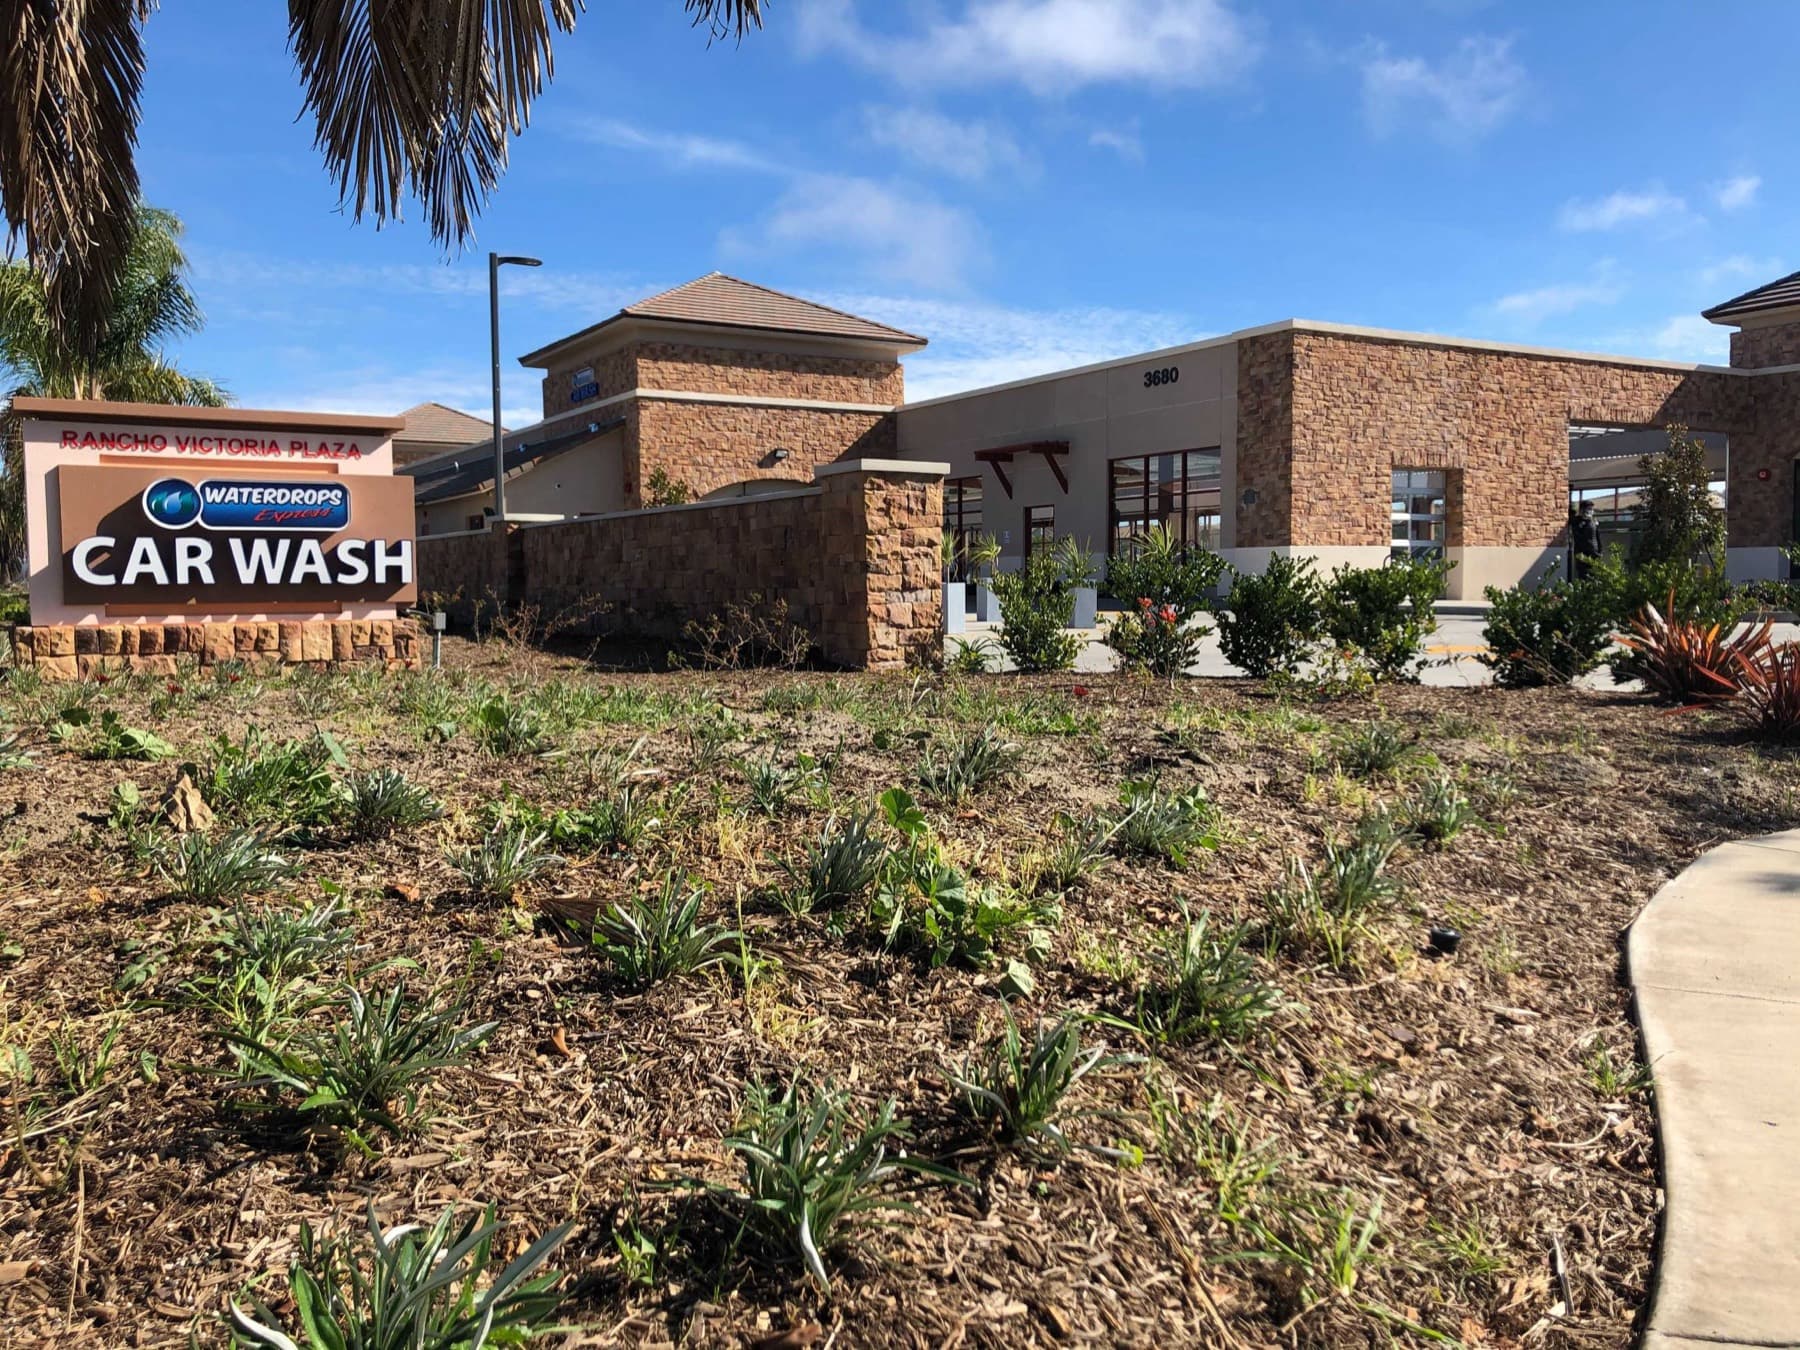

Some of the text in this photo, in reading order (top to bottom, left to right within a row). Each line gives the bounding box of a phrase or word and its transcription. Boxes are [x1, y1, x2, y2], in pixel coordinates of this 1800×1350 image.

[1144, 366, 1179, 388] 3680
[61, 430, 362, 461] RANCHO VICTORIA PLAZA
[205, 486, 342, 506] WATERDROPS
[254, 508, 332, 523] Express
[72, 536, 412, 586] CAR WASH
